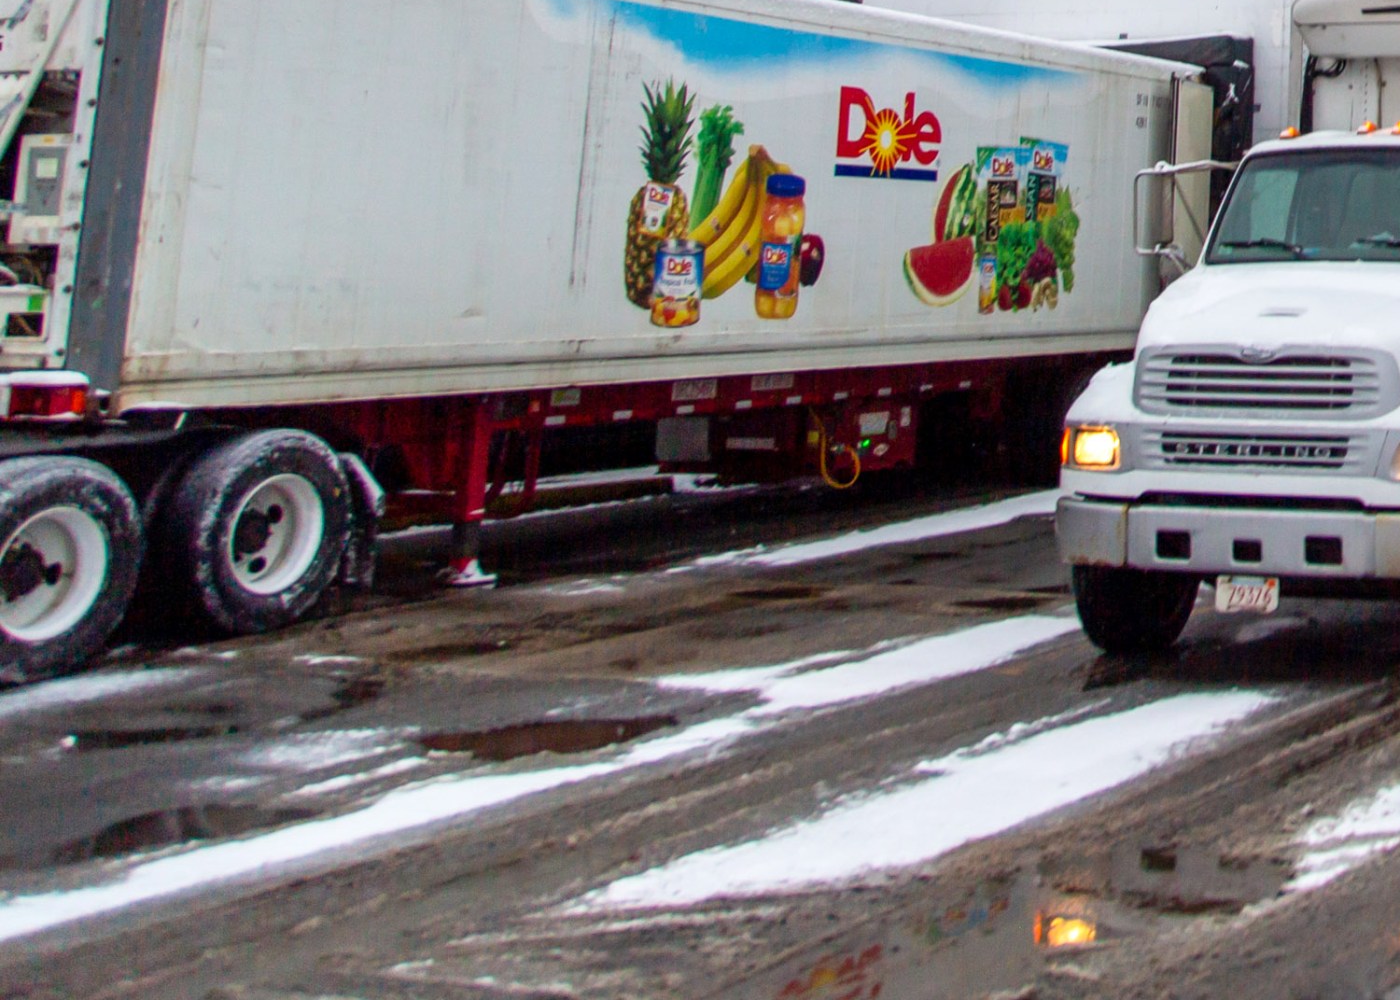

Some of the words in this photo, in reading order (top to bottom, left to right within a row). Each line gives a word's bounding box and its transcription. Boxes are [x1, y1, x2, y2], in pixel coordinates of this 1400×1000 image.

[836, 85, 943, 171] Dole
[992, 157, 1015, 175] Dole
[1033, 150, 1054, 170] Dole
[649, 186, 670, 204] Dole
[764, 246, 788, 264] Dole
[666, 257, 693, 274] Dole
[1174, 441, 1332, 459] STERLING
